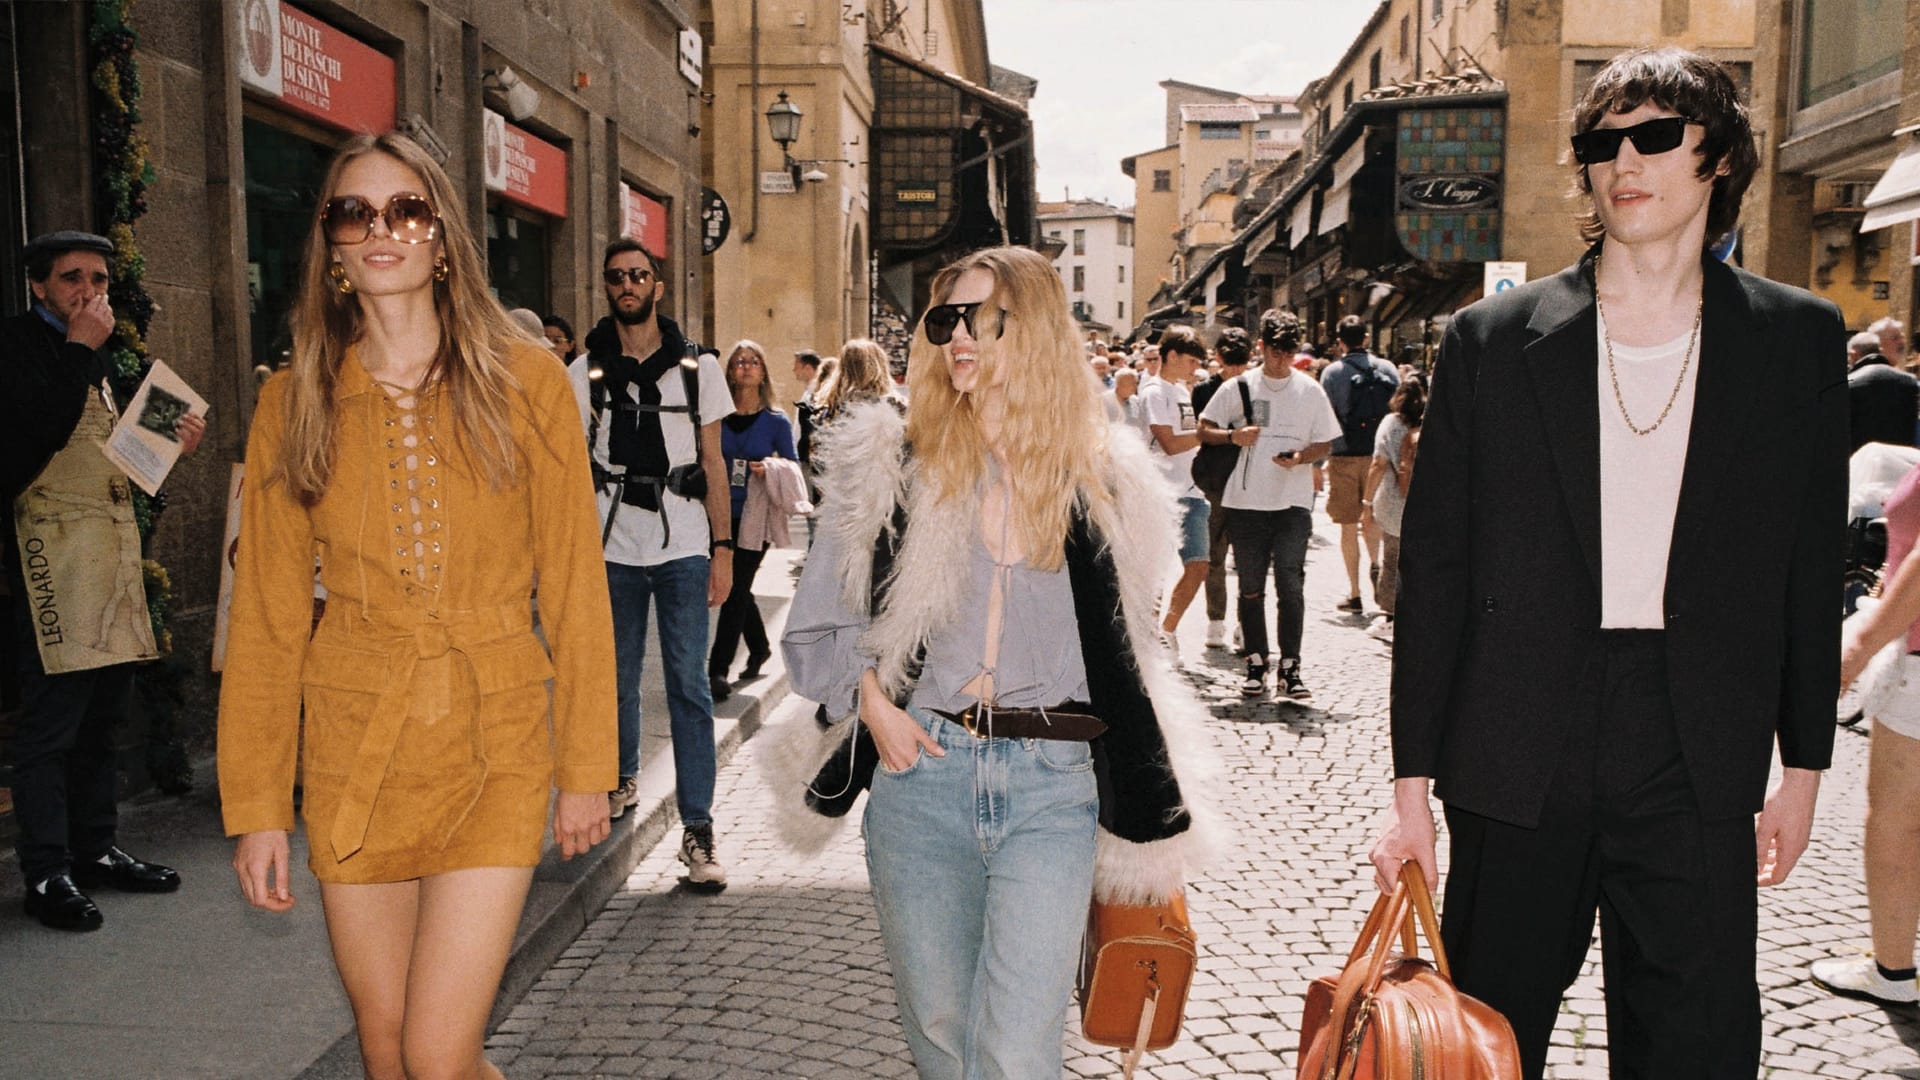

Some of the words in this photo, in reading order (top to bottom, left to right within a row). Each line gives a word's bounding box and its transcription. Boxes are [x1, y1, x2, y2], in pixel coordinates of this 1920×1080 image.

[281, 11, 321, 50] MONTE
[283, 35, 302, 62] DEI
[304, 46, 341, 81] PASCHI
[284, 58, 296, 83] DI
[297, 65, 330, 98] SIENA
[25, 537, 63, 646] LEONARDO
